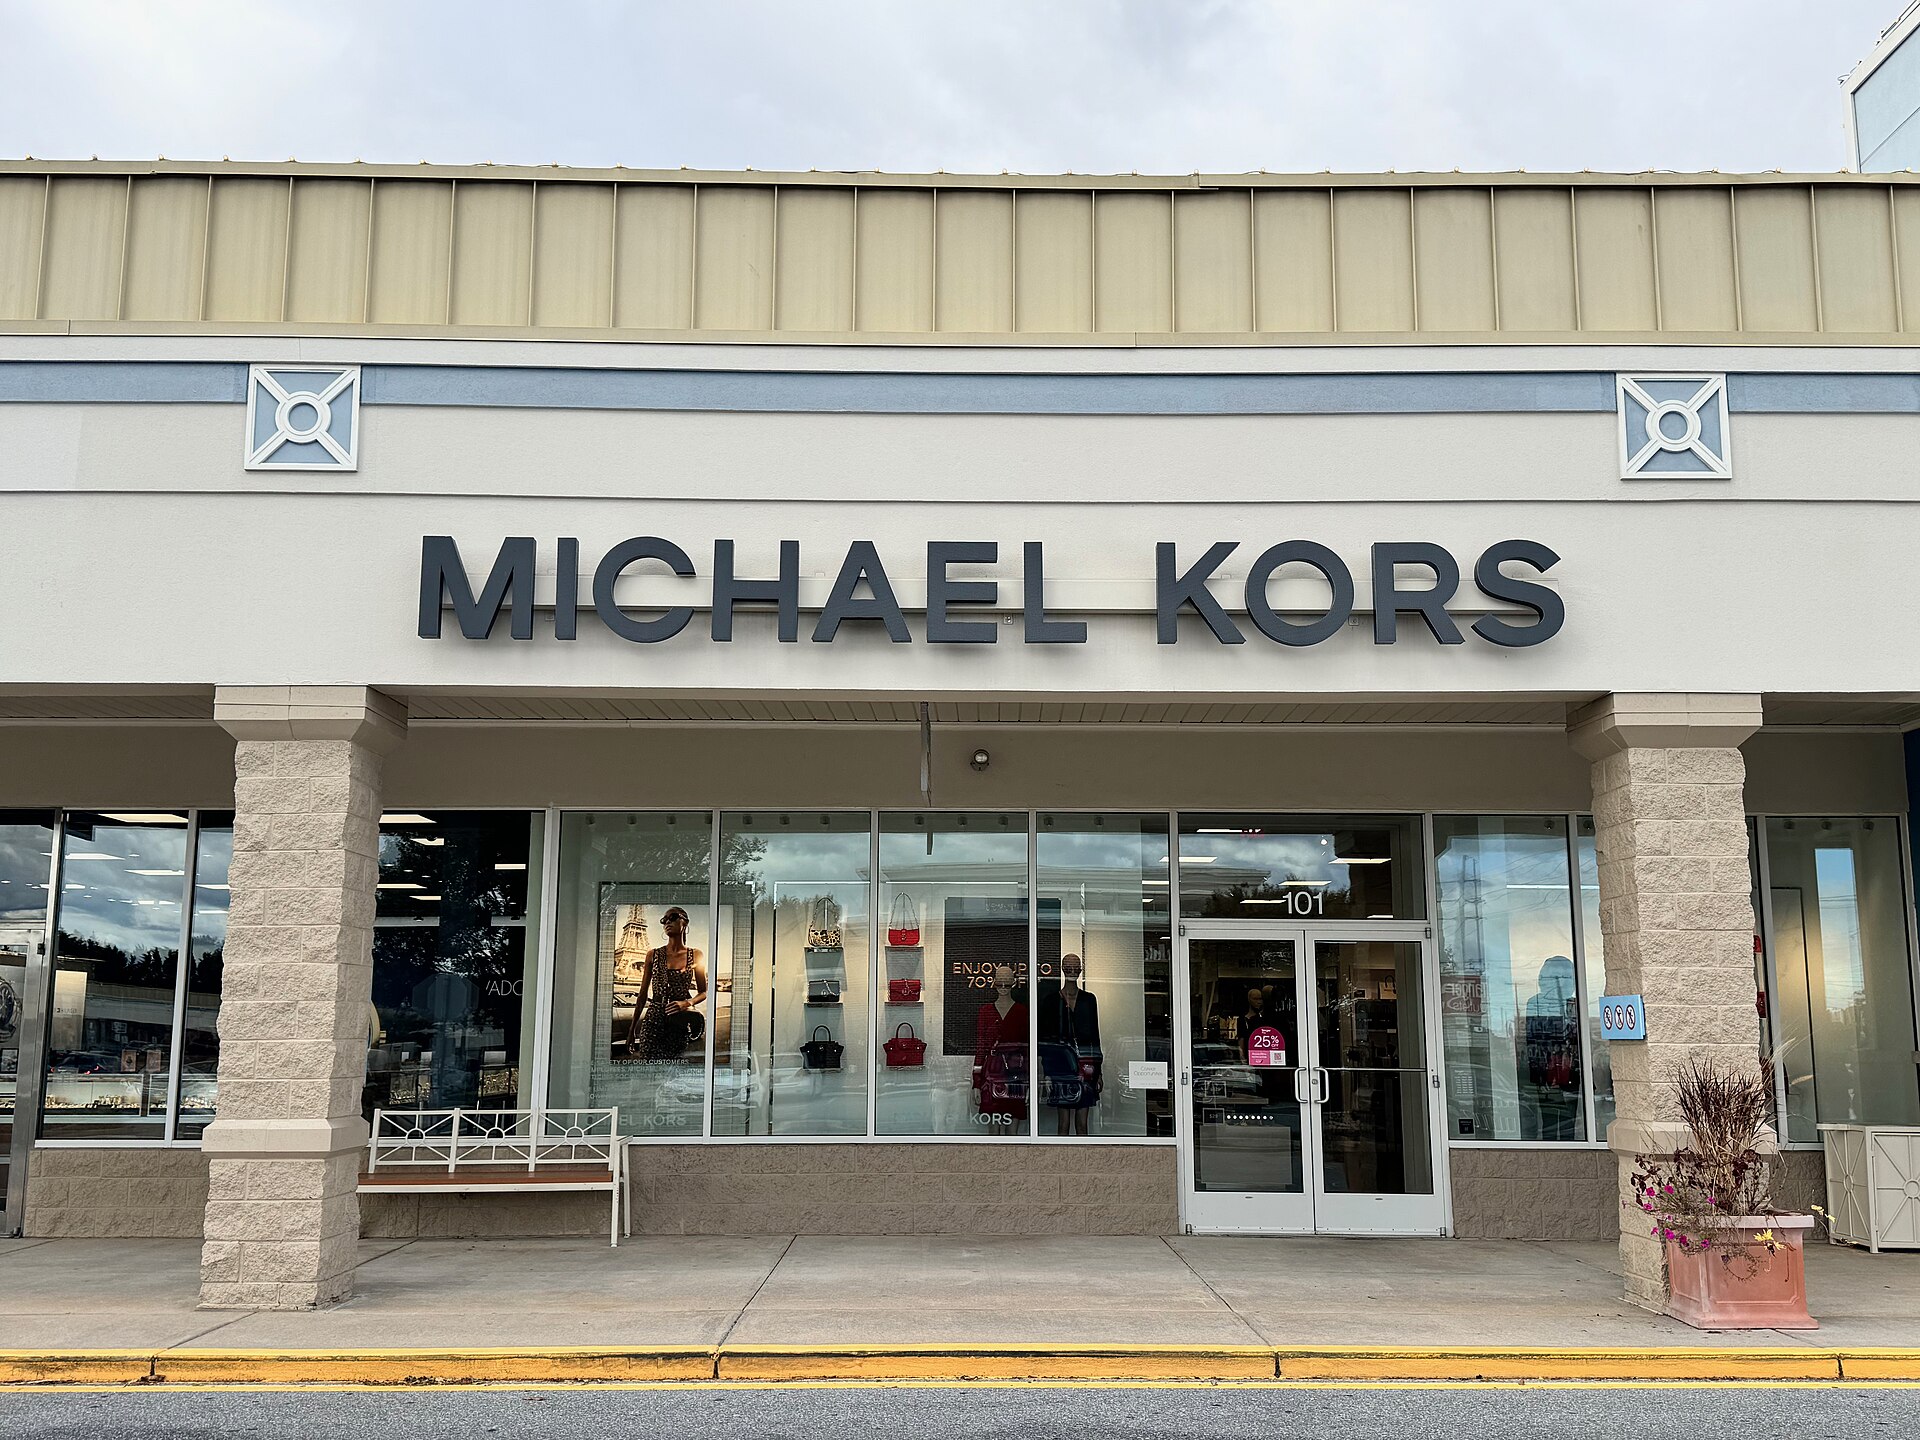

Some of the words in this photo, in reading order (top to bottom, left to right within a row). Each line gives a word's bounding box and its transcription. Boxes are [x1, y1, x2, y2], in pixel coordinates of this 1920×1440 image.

[418, 535, 1087, 645] MICHAEL
[1156, 539, 1566, 648] KORS
[1282, 891, 1323, 915] 101
[951, 962, 1002, 975] ENJOY
[1037, 963, 1052, 975] O
[1254, 1035, 1279, 1048] 25%
[969, 1112, 1013, 1125] KORS
